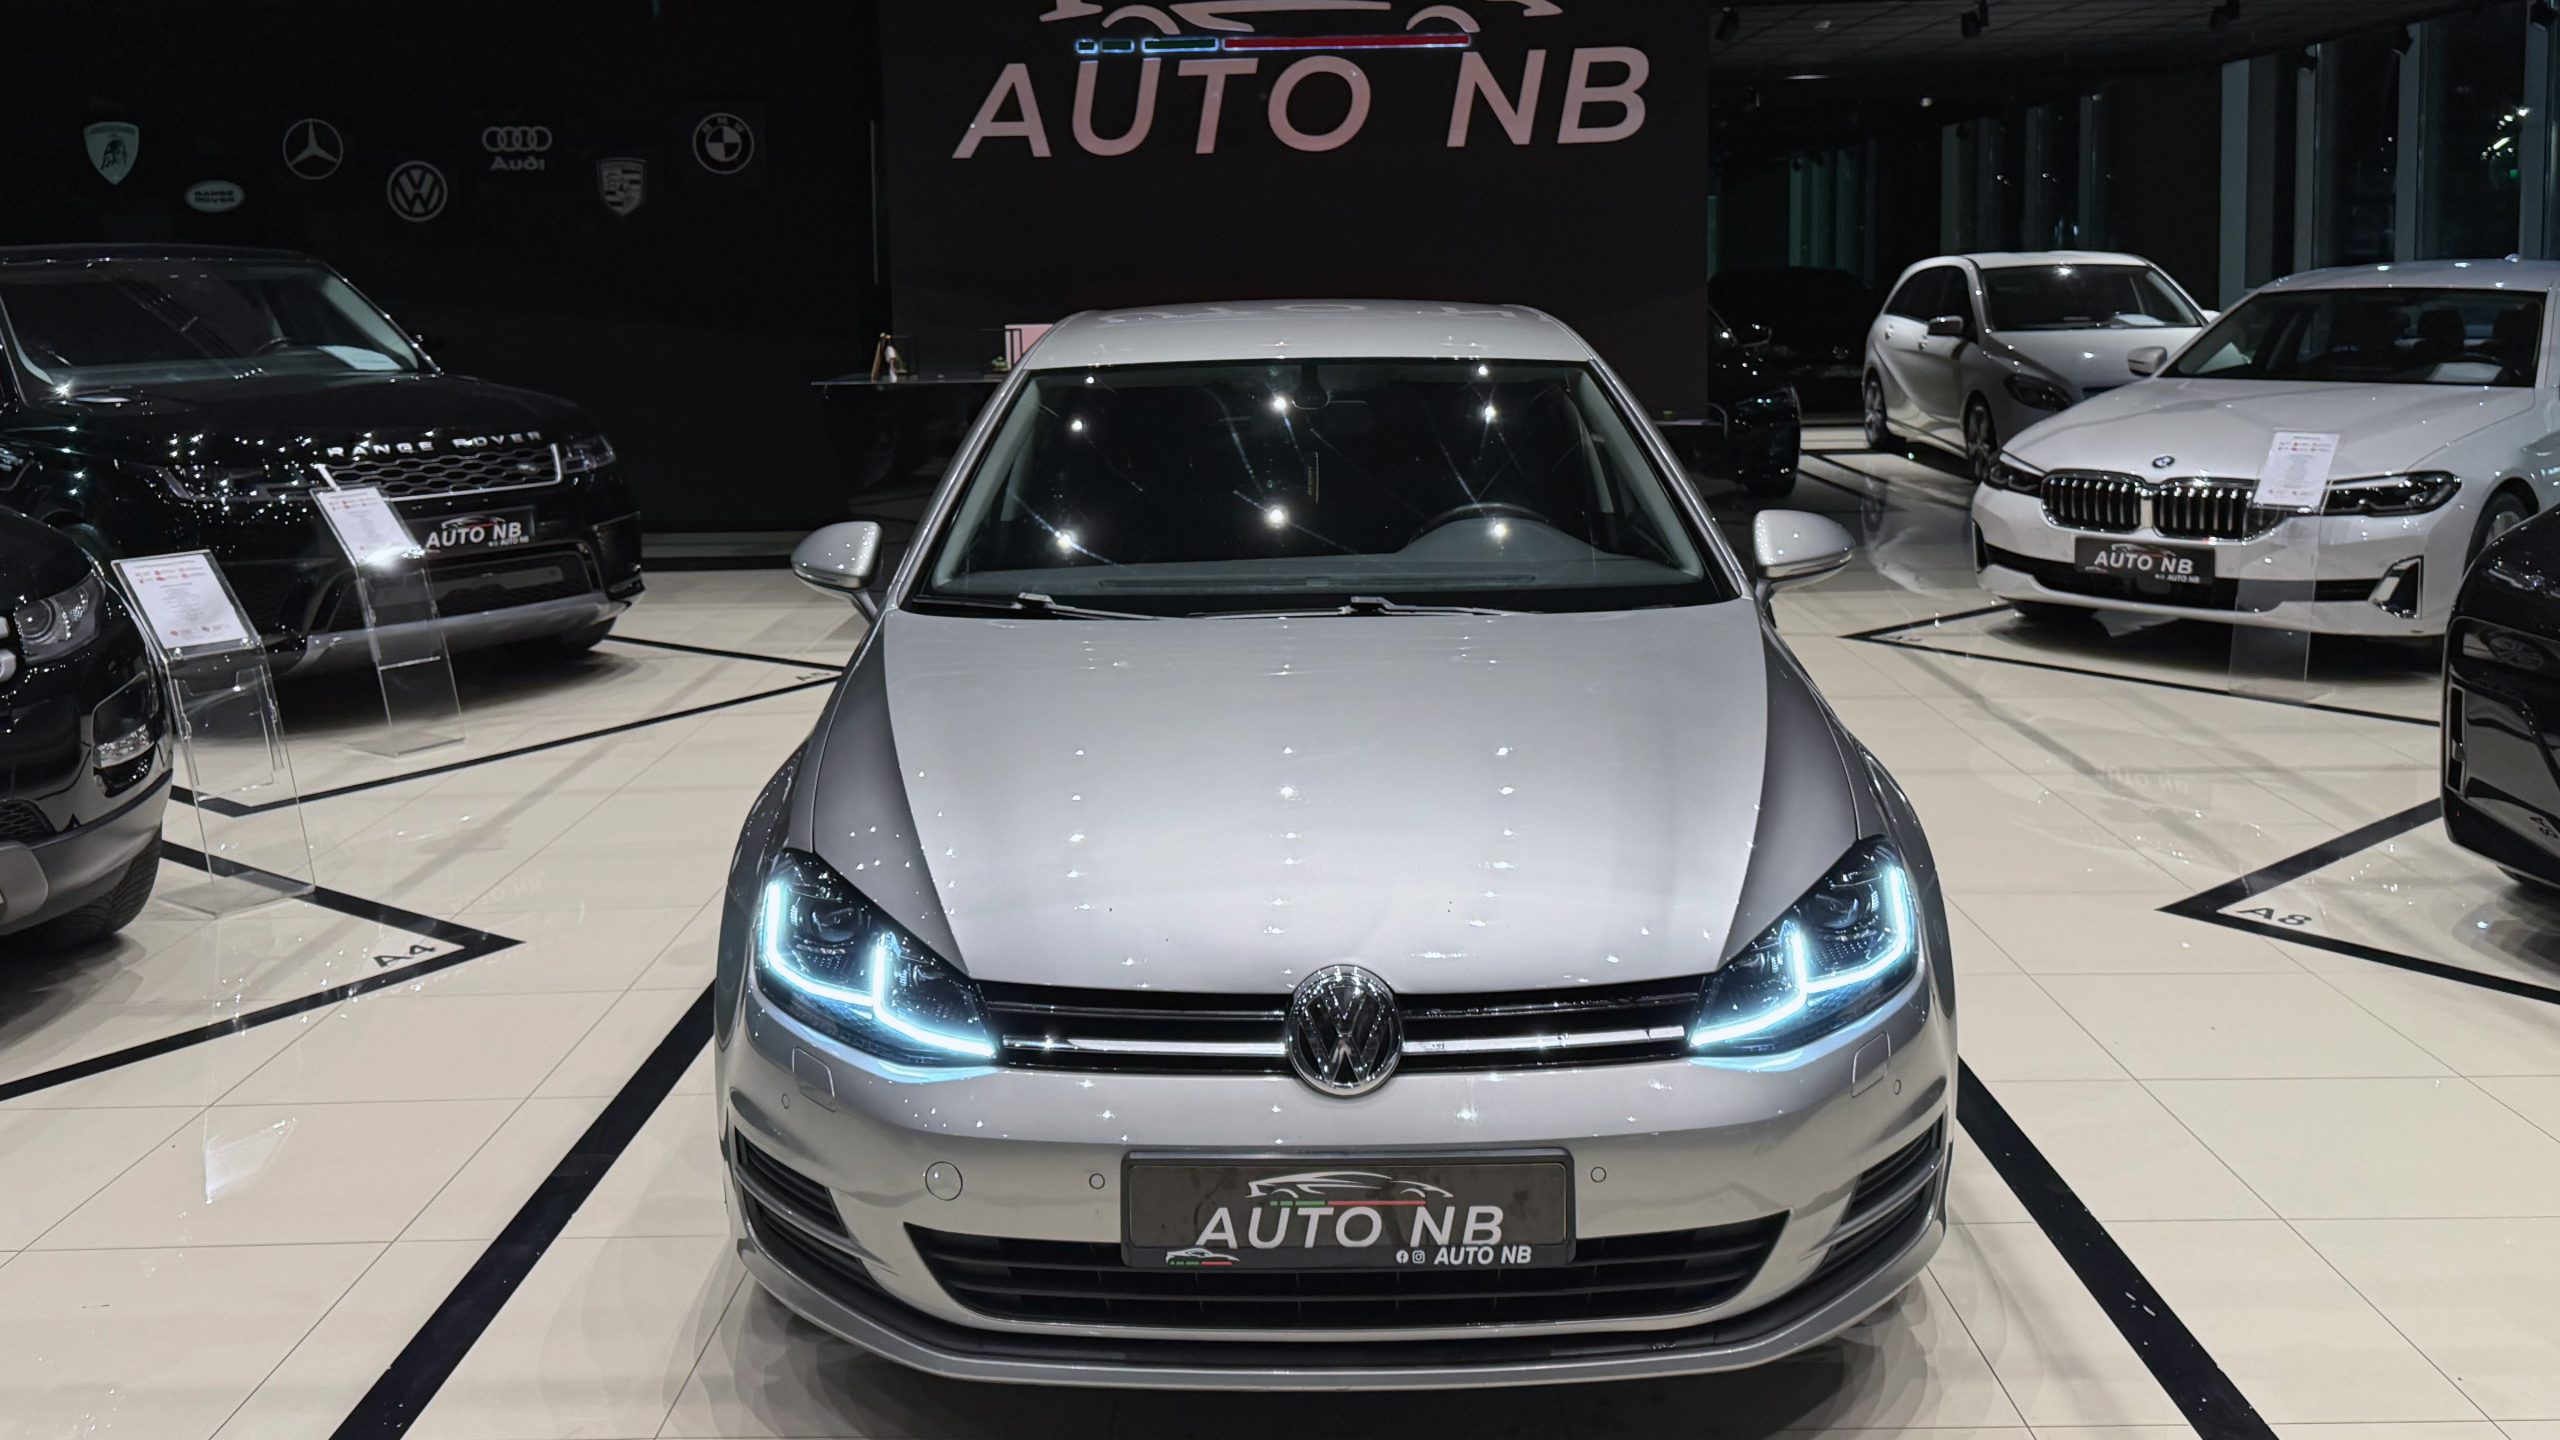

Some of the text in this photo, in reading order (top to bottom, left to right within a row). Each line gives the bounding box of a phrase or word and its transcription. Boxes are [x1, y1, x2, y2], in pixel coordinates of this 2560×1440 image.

[952, 46, 1651, 159] AUTO NB
[489, 155, 545, 172] Audi
[326, 431, 543, 458] RANGE ROVER
[425, 521, 522, 549] AUTO NB
[500, 535, 529, 546] AUTO NB
[2094, 550, 2194, 574] AUTO NB
[2167, 574, 2200, 584] AUTO NB
[2237, 906, 2312, 927] A8
[373, 944, 435, 968] A4
[1195, 1205, 1504, 1250] AUTO NB
[1433, 1245, 1532, 1265] AUTO NB
